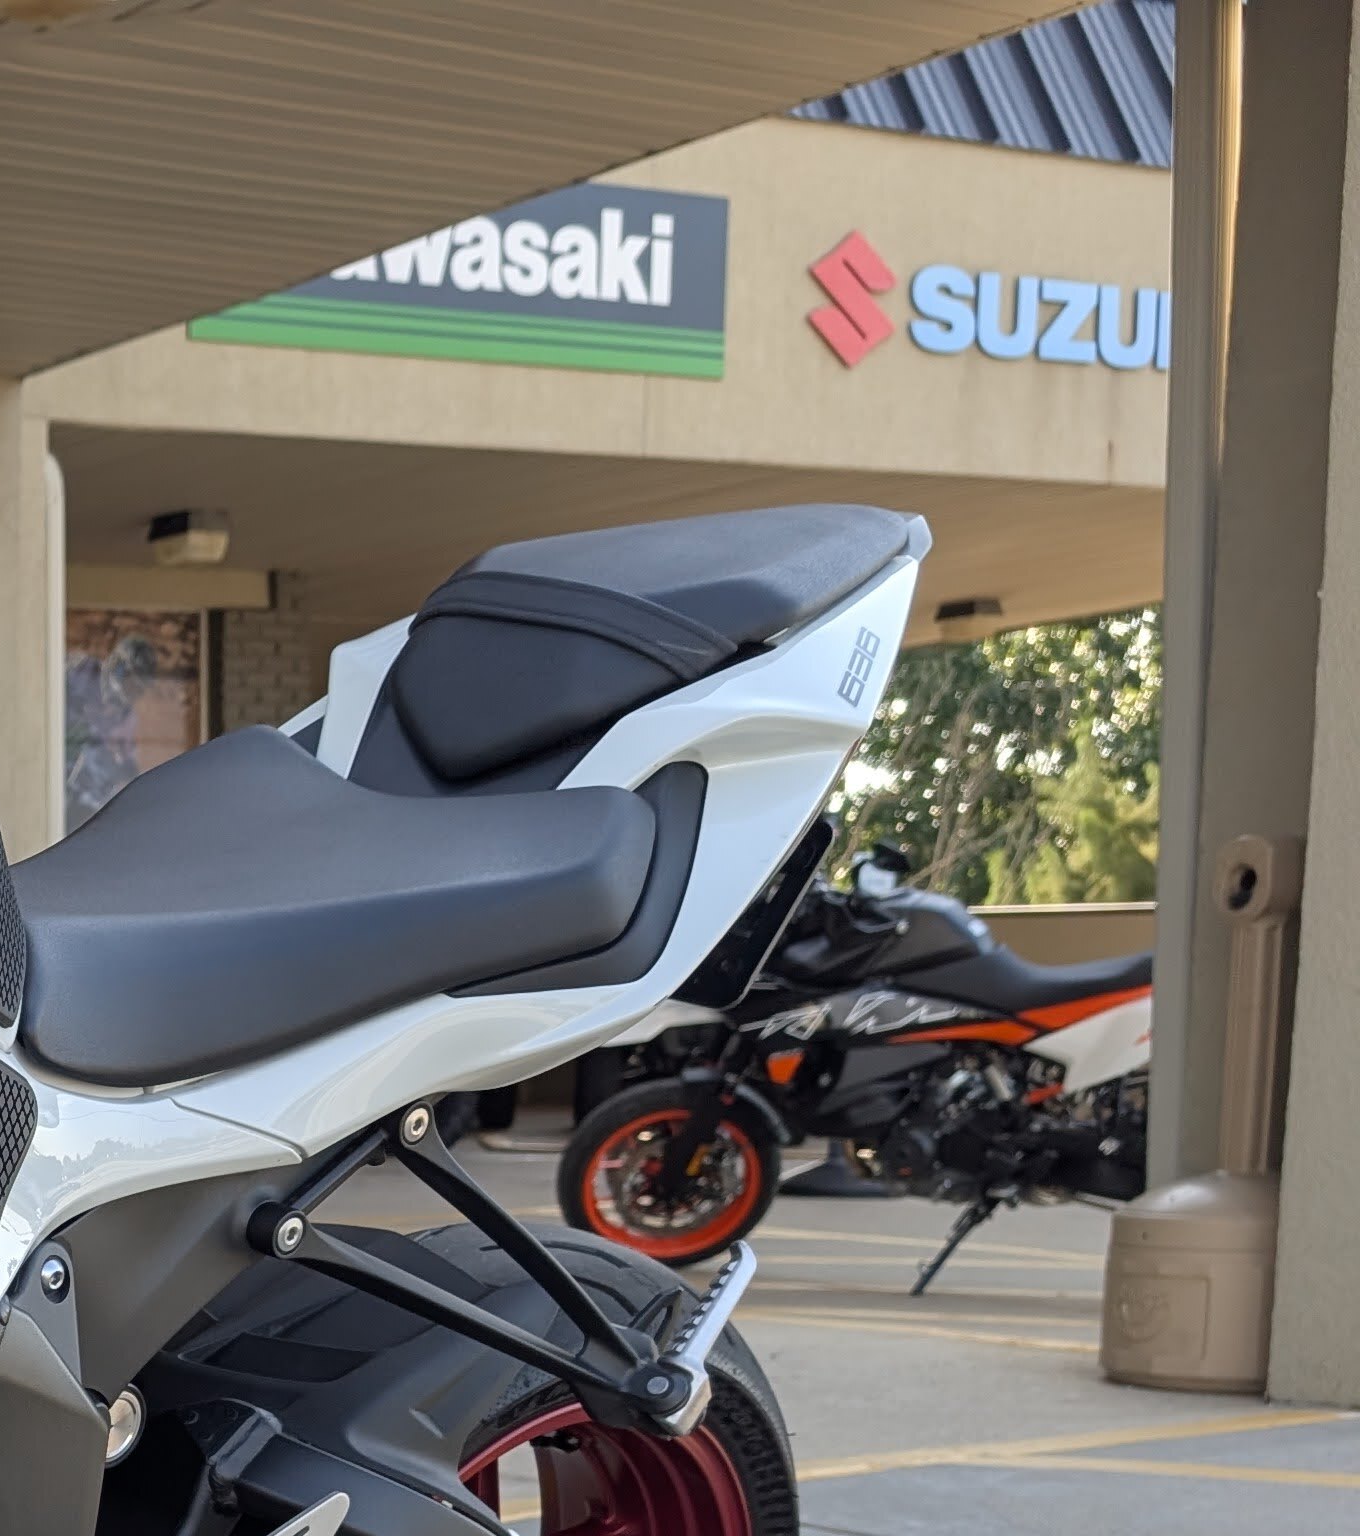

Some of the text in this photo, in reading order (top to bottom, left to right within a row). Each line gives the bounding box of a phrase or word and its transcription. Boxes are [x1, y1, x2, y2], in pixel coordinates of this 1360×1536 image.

[330, 207, 675, 307] wasaki
[909, 263, 1171, 370] SUZU
[837, 626, 881, 708] 636
